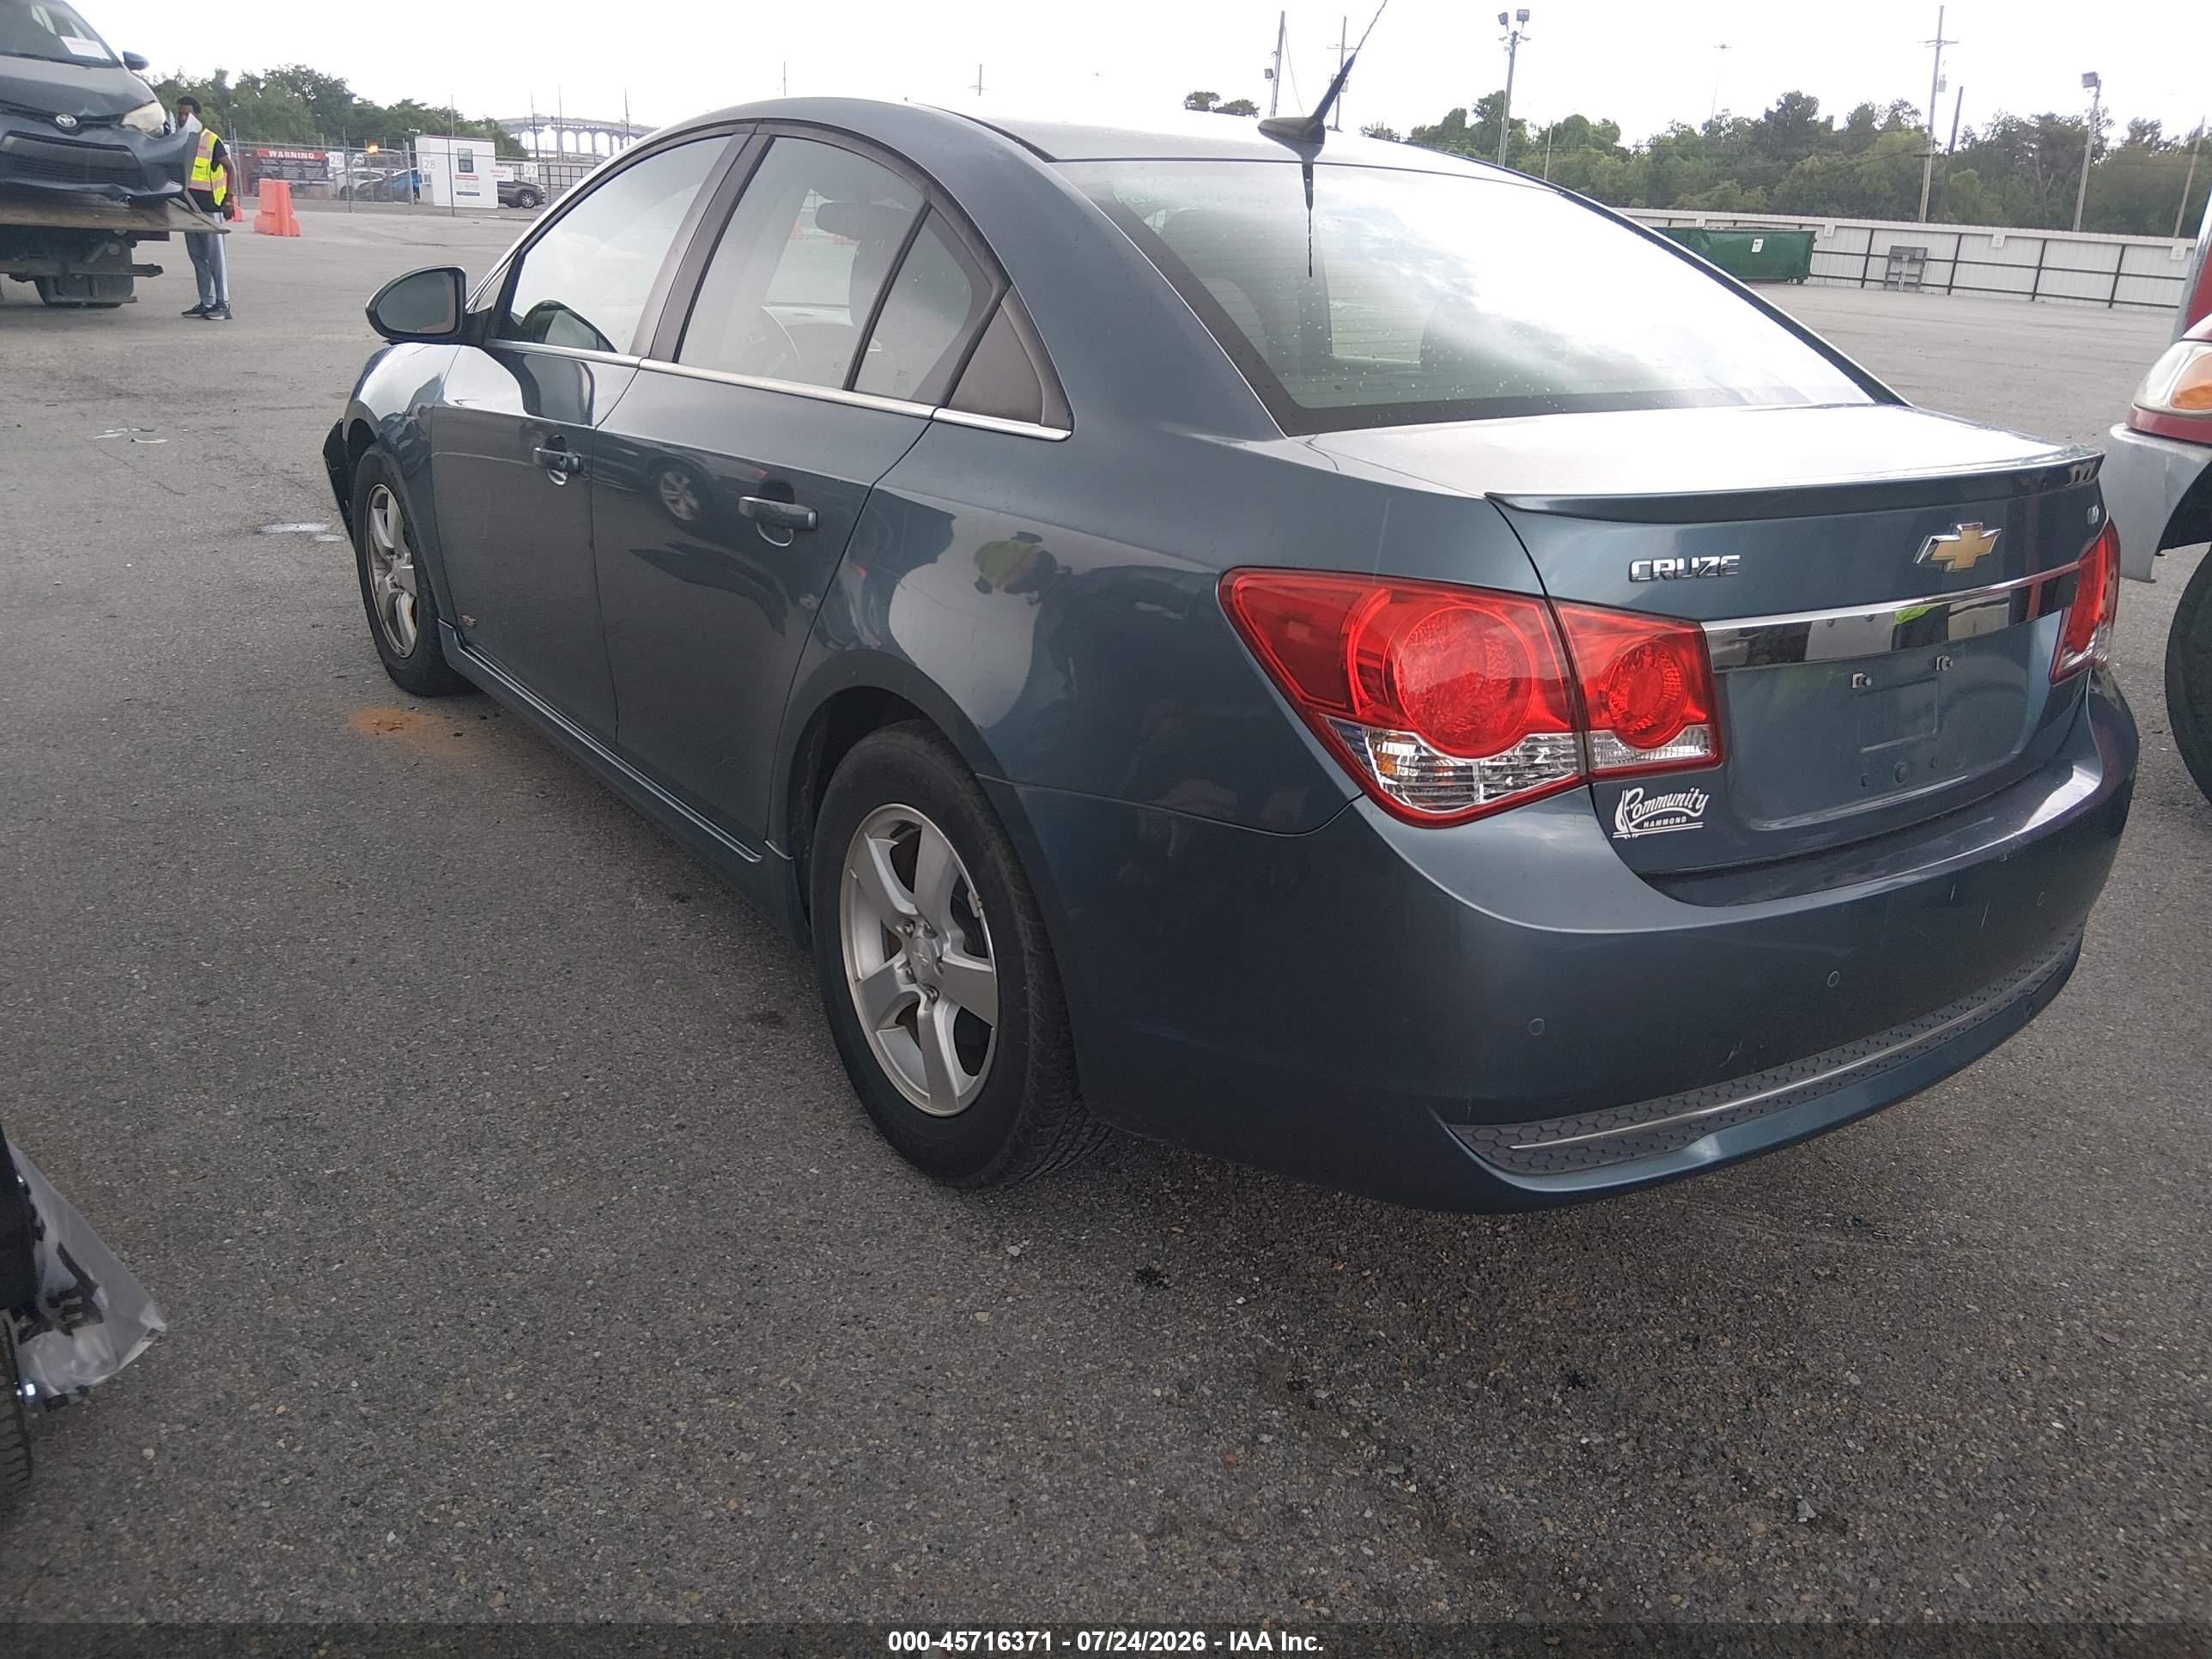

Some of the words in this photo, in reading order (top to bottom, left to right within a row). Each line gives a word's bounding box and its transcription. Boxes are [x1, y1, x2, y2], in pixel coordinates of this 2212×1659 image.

[269, 150, 315, 160] WARNING
[330, 155, 343, 165] 29
[423, 160, 436, 170] 28
[525, 165, 537, 175] 27
[1629, 554, 1741, 582] CRUZE
[1643, 816, 1687, 829] HAMMOND
